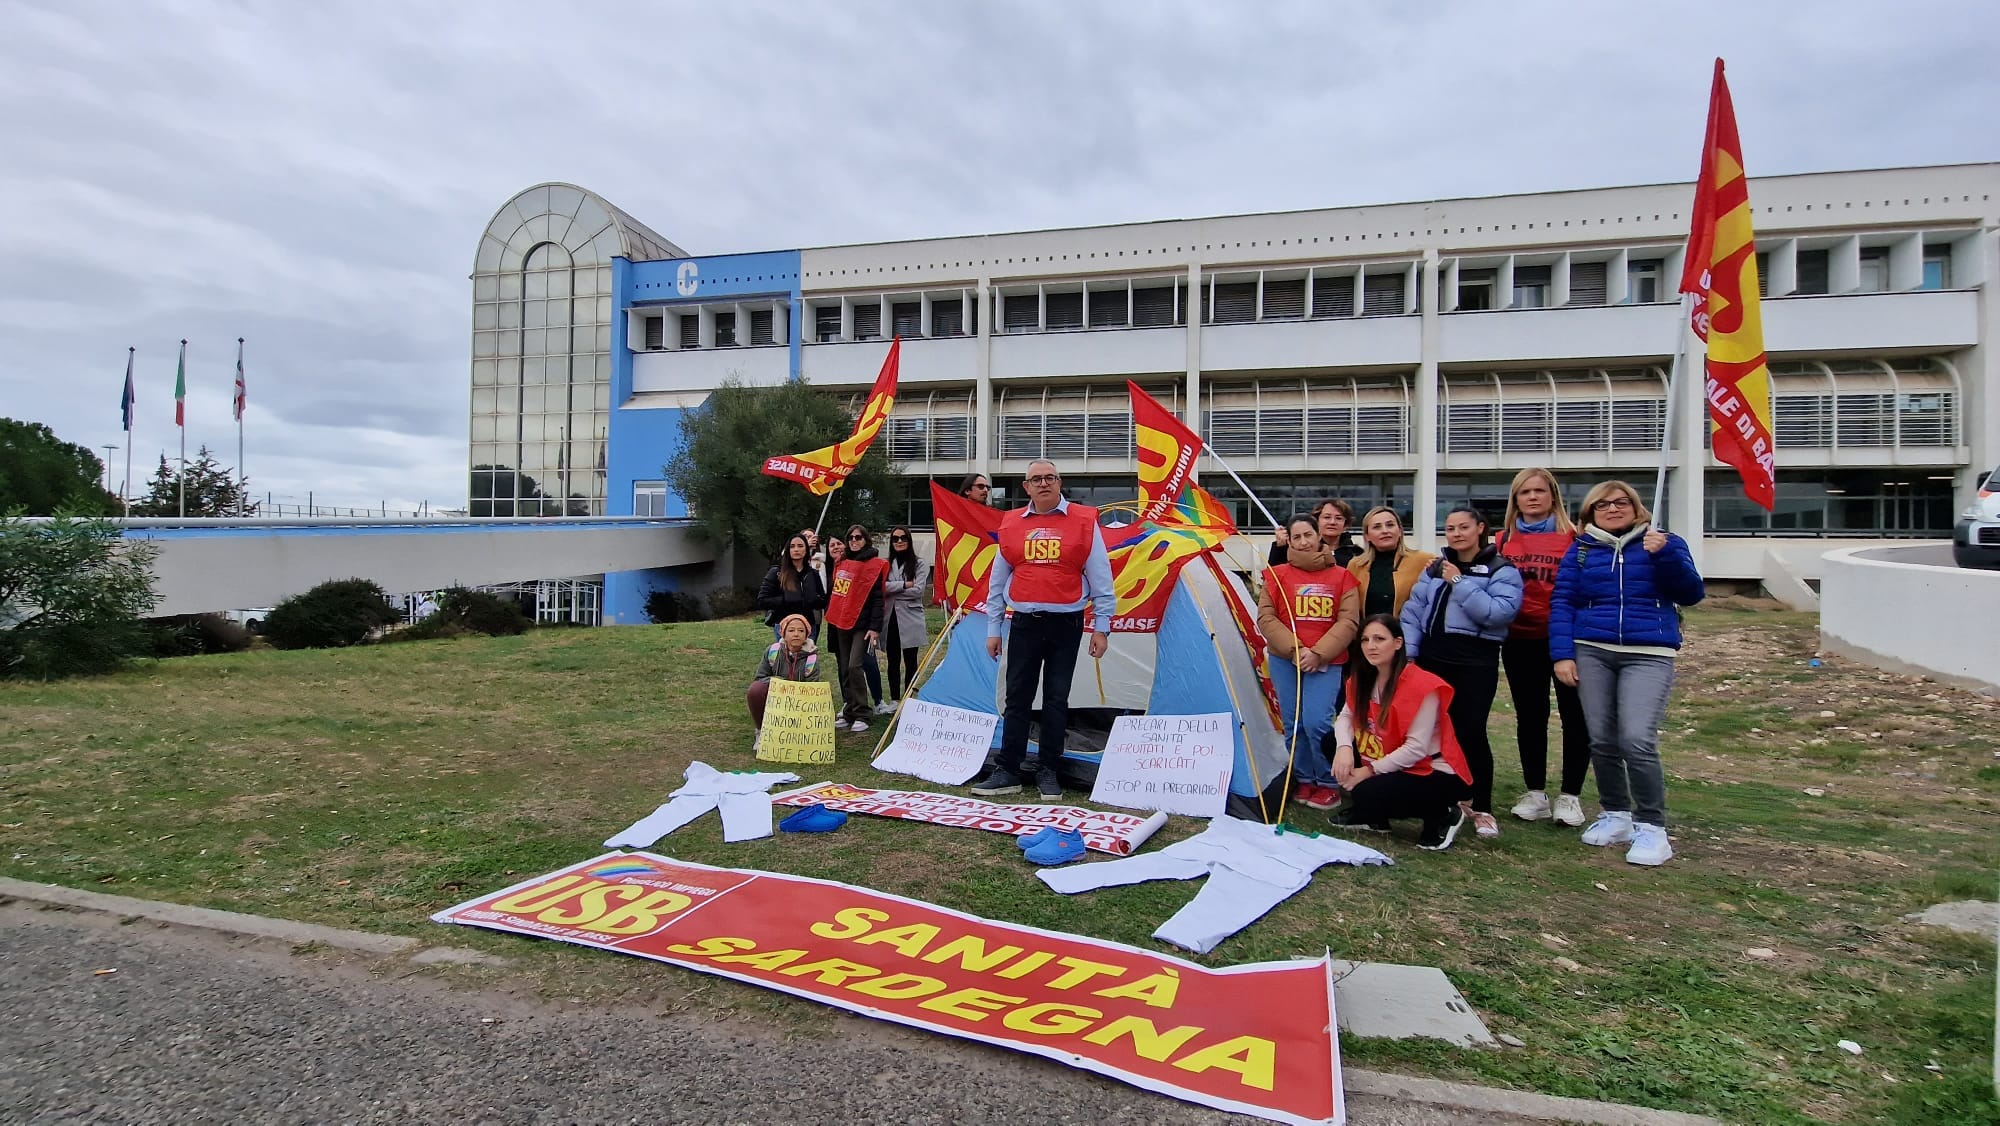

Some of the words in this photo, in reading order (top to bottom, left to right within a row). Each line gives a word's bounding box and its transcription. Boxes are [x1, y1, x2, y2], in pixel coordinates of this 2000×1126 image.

[676, 262, 698, 296] C
[1736, 412, 1756, 441] DI
[1024, 539, 1061, 561] USB
[1504, 553, 1562, 565] SSUNZION
[833, 578, 851, 594] SB
[1295, 595, 1334, 618] USB
[1122, 719, 1168, 732] PRECARI
[1178, 719, 1219, 733] DELLA
[797, 750, 805, 762] E
[810, 750, 835, 763] CURE
[1174, 744, 1182, 754] E
[1133, 757, 1196, 771] SCARICATI
[1104, 779, 1142, 793] STOP
[1145, 782, 1157, 793] AL
[888, 792, 1042, 814] OPERATORI
[669, 882, 718, 897] IMPIEGO
[490, 875, 692, 935] USB
[810, 907, 1181, 1009] SANITÀ
[667, 936, 1276, 1092] SARDEGNA
